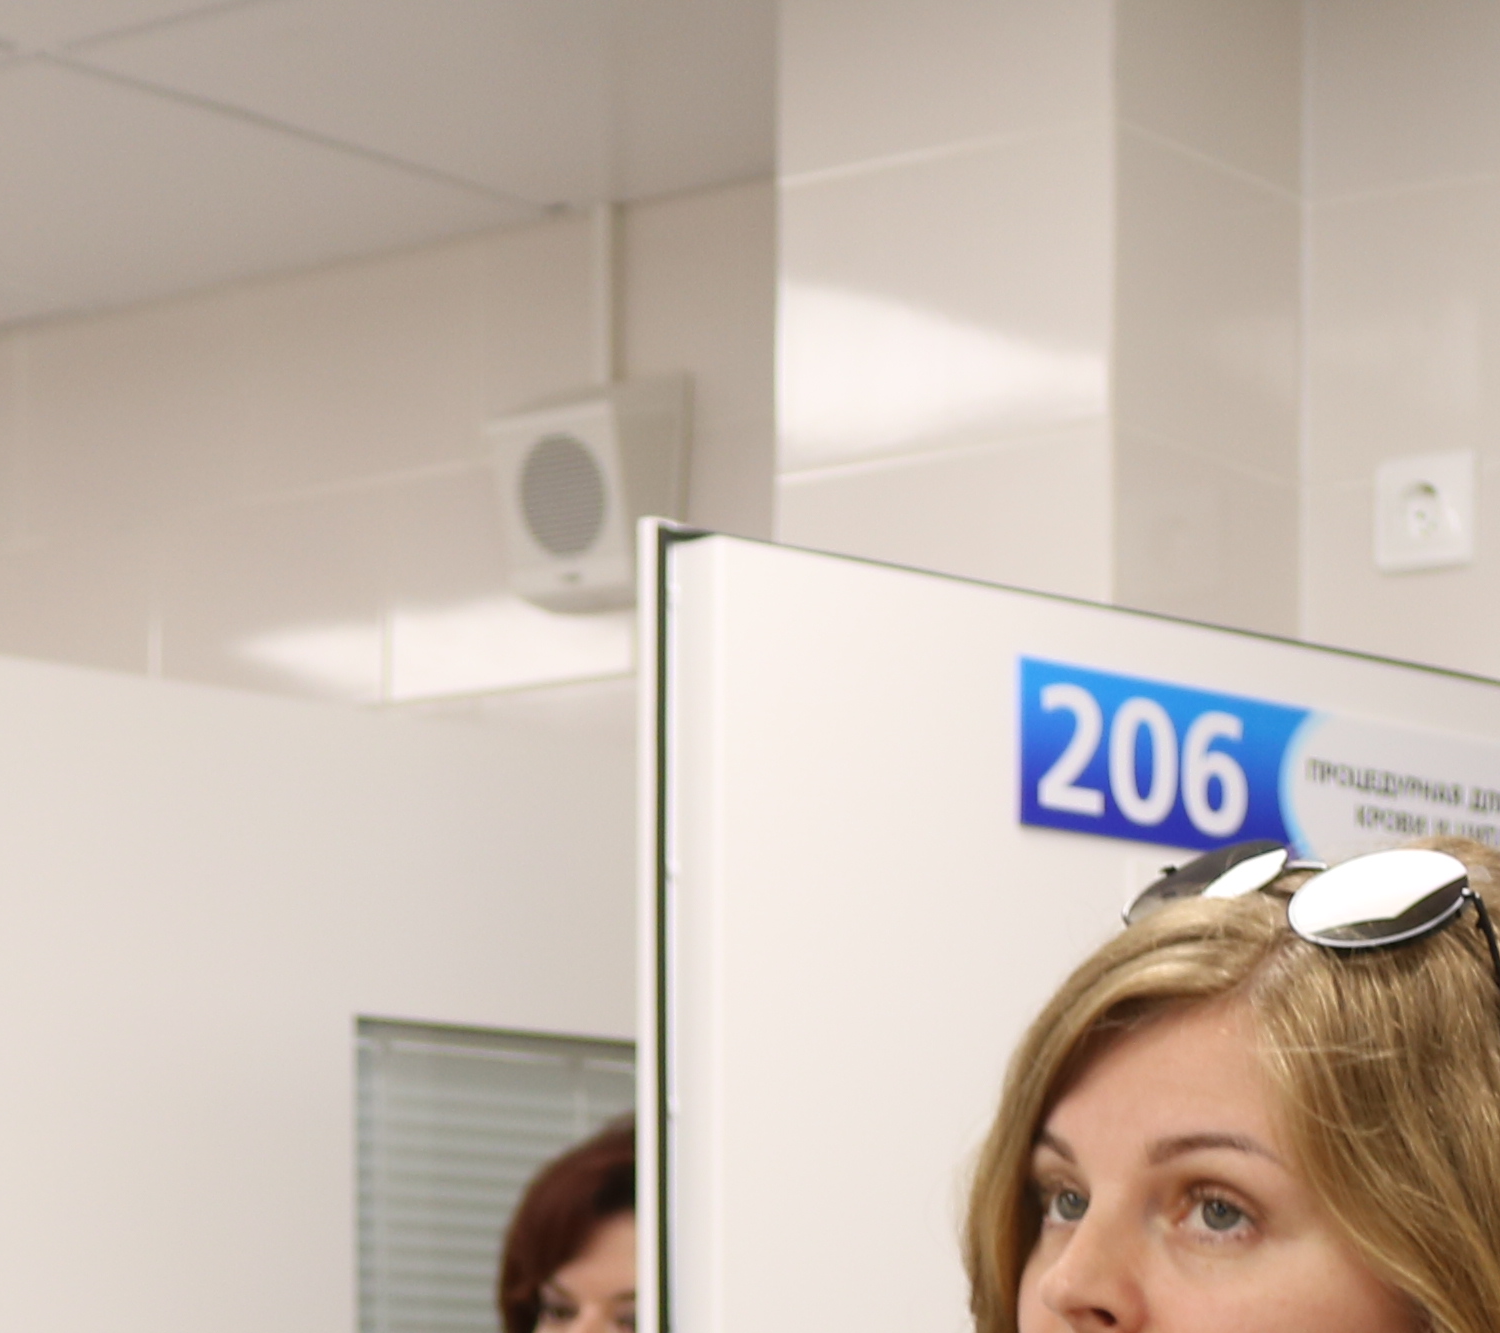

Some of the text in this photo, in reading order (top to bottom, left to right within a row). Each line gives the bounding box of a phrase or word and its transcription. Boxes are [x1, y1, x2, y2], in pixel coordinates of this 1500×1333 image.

[1037, 684, 1249, 838] 206
[1306, 758, 1462, 806] ПРОЦЕДУРНАЯ
[1356, 805, 1425, 836] КРОВИ
